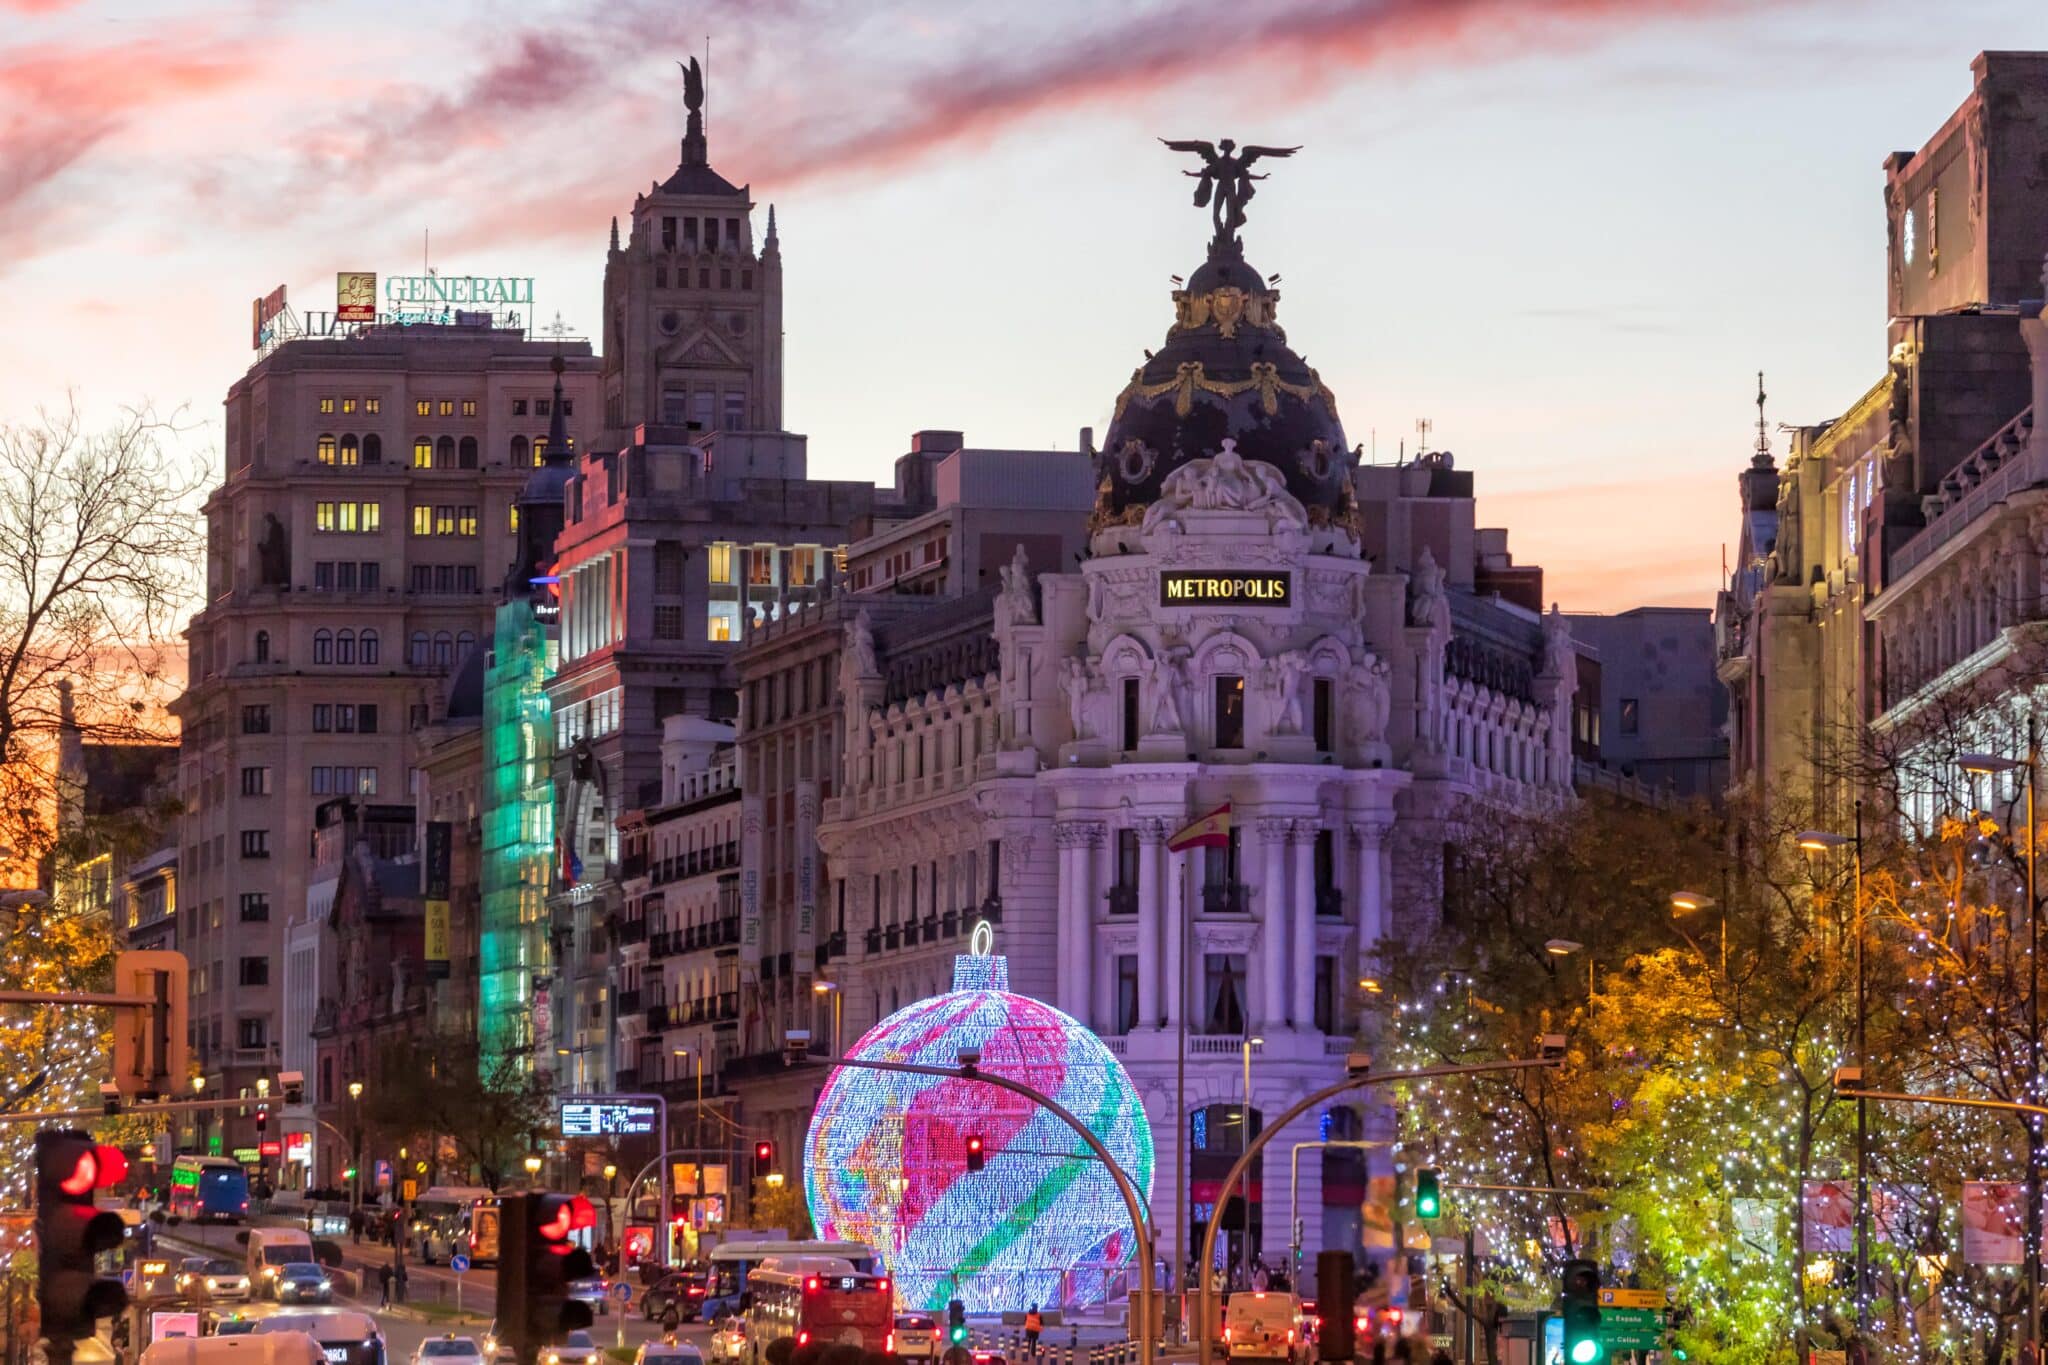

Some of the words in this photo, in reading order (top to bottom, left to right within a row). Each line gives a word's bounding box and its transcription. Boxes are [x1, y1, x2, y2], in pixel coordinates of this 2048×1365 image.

[385, 276, 535, 303] GENERALI
[1167, 579, 1285, 598] METROPOLIS
[744, 870, 756, 914] salida
[745, 917, 760, 946] hay
[799, 905, 815, 935] hay
[842, 1278, 855, 1288] 51
